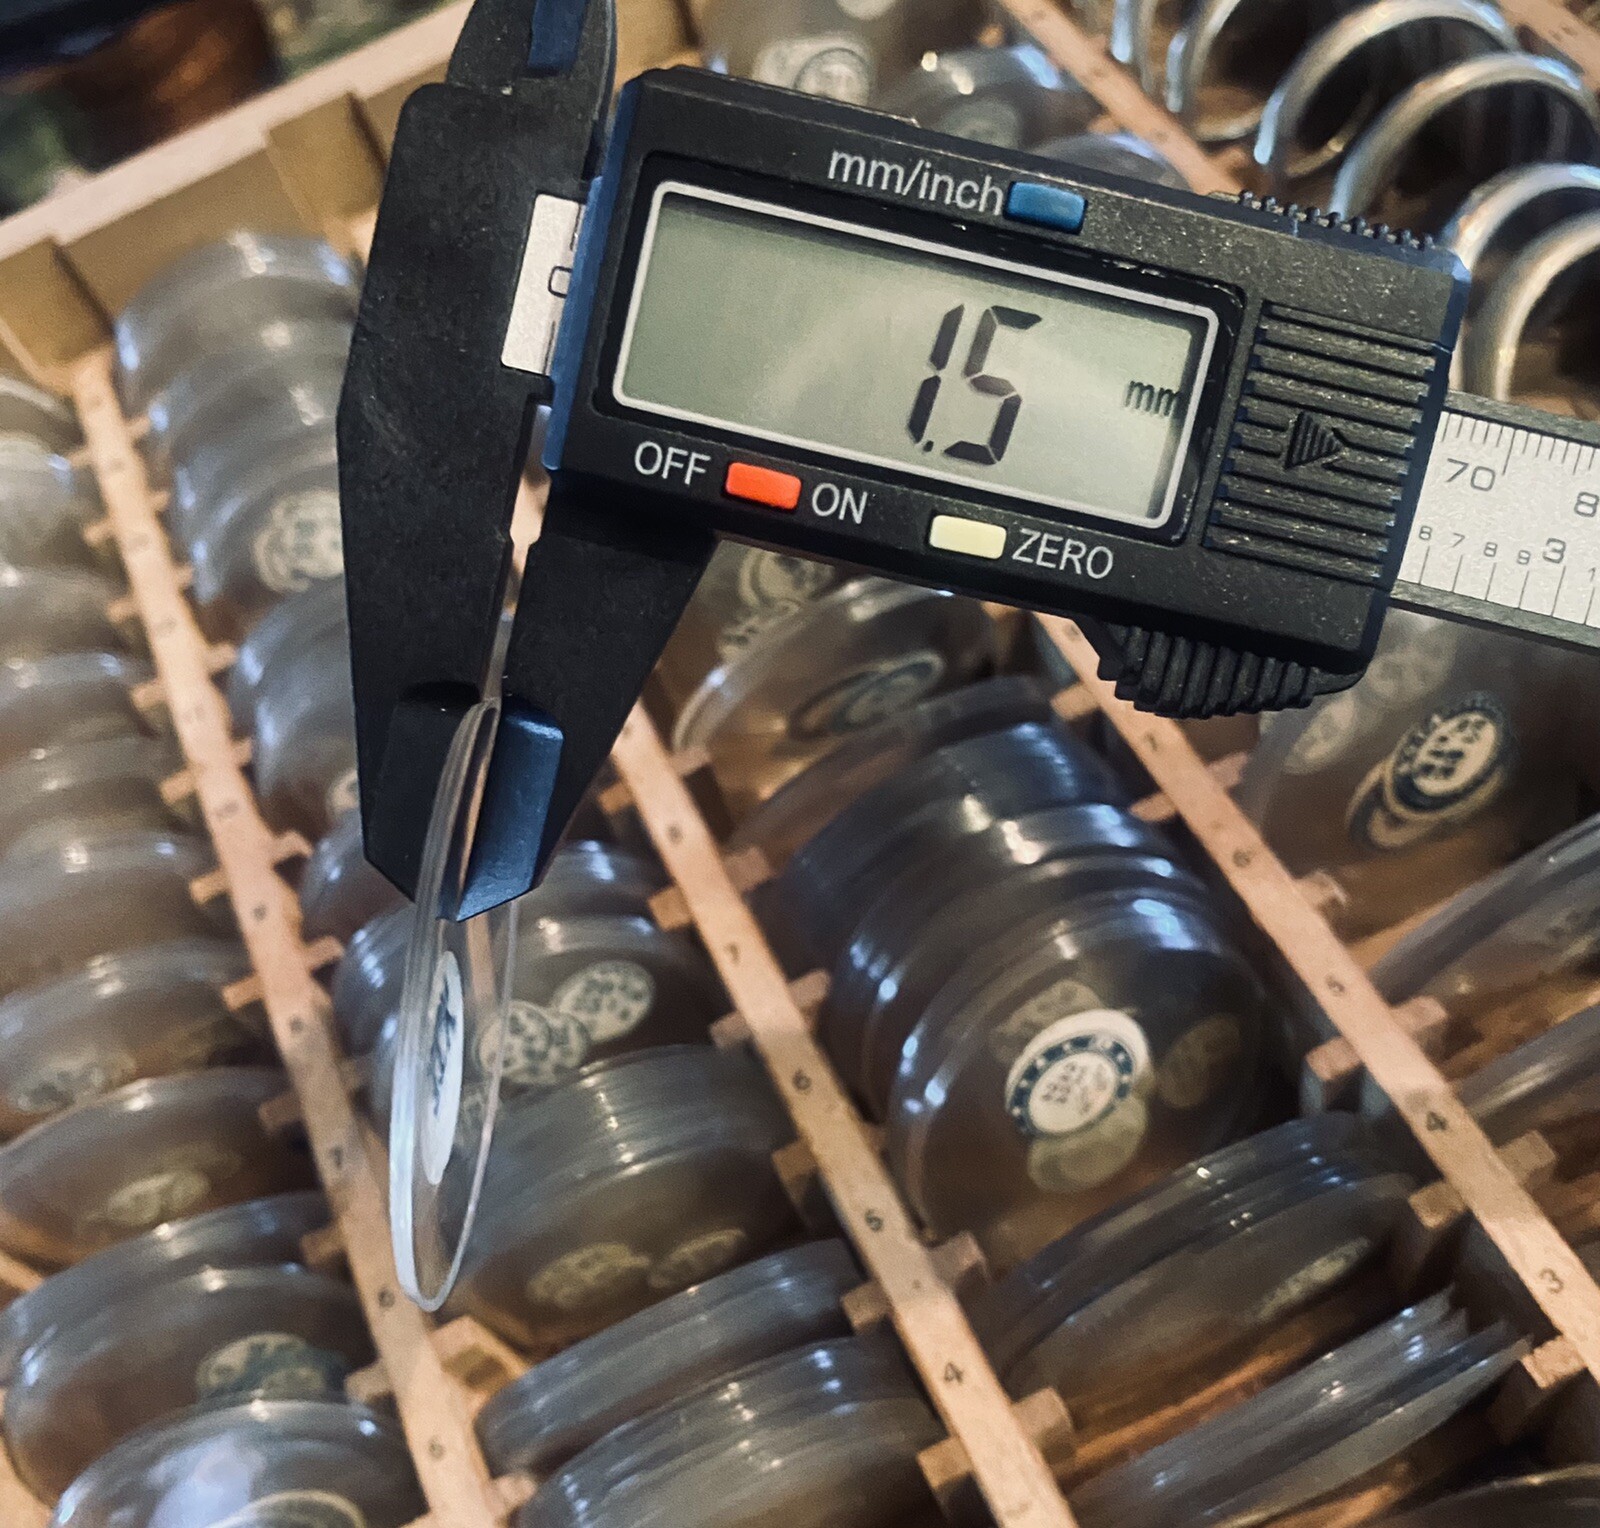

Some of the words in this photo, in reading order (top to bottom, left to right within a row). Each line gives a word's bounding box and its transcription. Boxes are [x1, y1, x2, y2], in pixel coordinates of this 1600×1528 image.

[827, 149, 1004, 216] mm/inch
[906, 303, 1042, 466] 1.5
[1124, 379, 1181, 418] mm
[634, 441, 711, 484] OFF
[1445, 457, 1496, 492] 70
[811, 482, 868, 525] ON
[1011, 527, 1114, 580] ZERO
[1451, 532, 1466, 548] 7
[1483, 541, 1498, 558] 8
[1542, 537, 1567, 564] 3
[1427, 1111, 1447, 1131] 4
[1539, 1266, 1564, 1295] 3
[944, 1362, 963, 1384] 4
